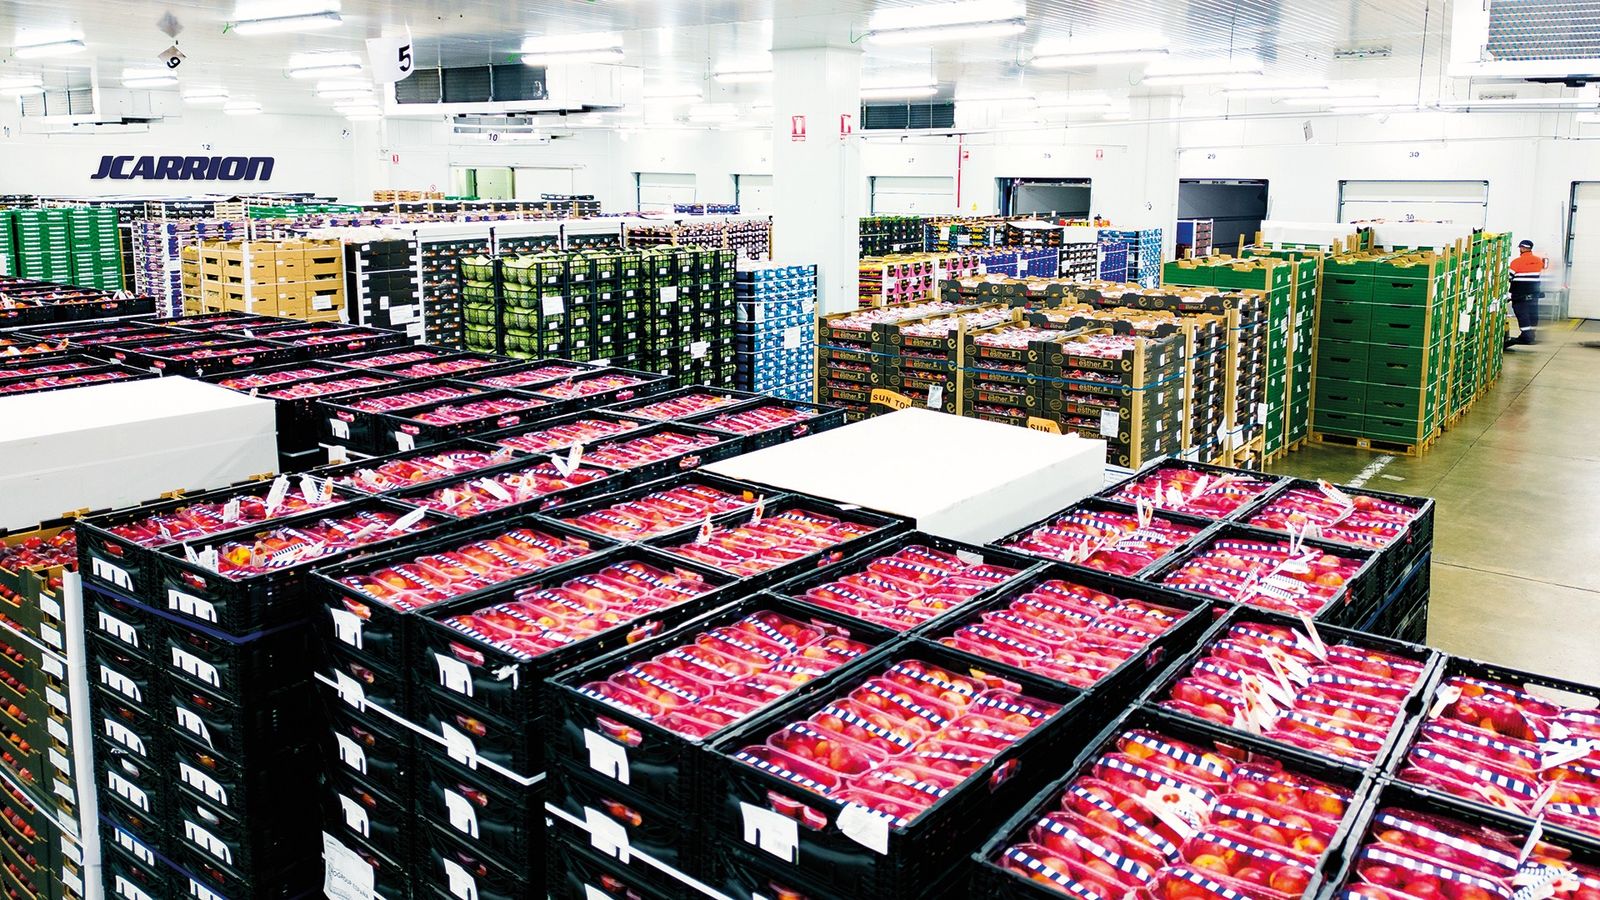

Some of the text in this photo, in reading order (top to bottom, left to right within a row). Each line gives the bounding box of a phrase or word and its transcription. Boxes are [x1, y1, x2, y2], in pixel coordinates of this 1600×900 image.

[398, 44, 411, 72] 5
[488, 133, 498, 141] 10
[91, 155, 275, 180] JCARRION
[872, 394, 892, 404] SUN
